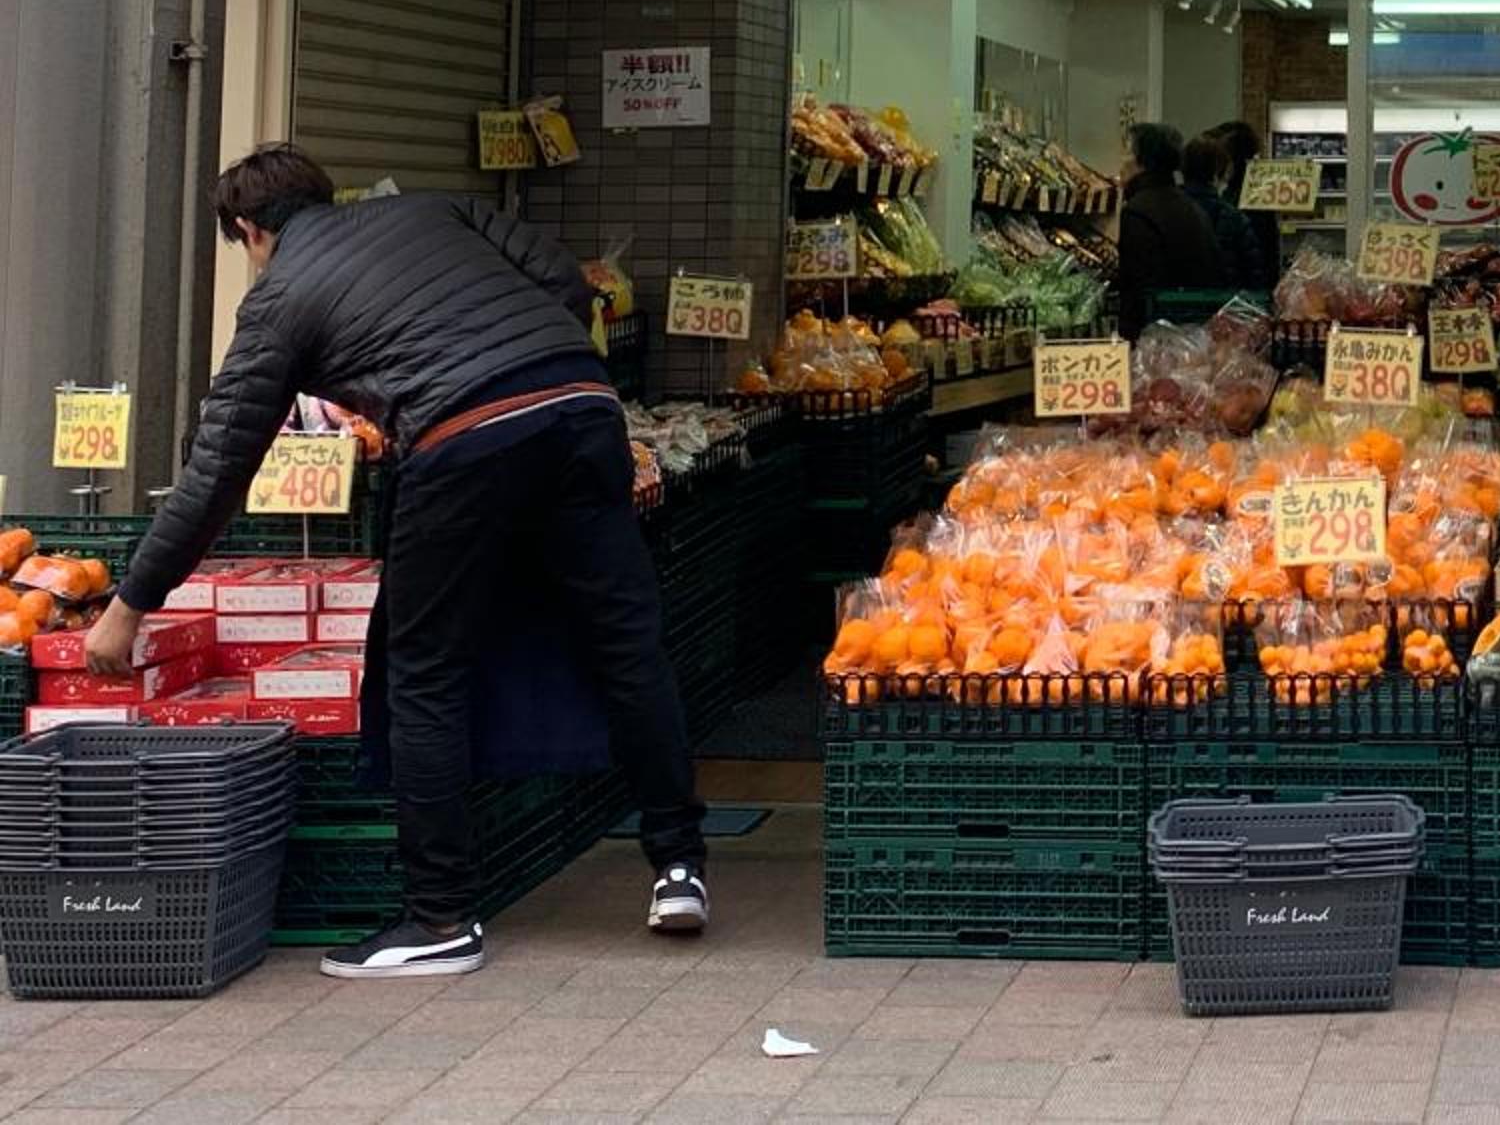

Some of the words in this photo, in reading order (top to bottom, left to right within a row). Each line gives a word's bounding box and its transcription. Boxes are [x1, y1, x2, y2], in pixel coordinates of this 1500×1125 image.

[605, 76, 702, 93] アイスクリーム
[1281, 487, 1375, 515] きんかん
[63, 896, 101, 913] Fresh
[105, 896, 143, 912] Land
[1247, 906, 1287, 926] Fresh
[1291, 906, 1331, 924] Land
